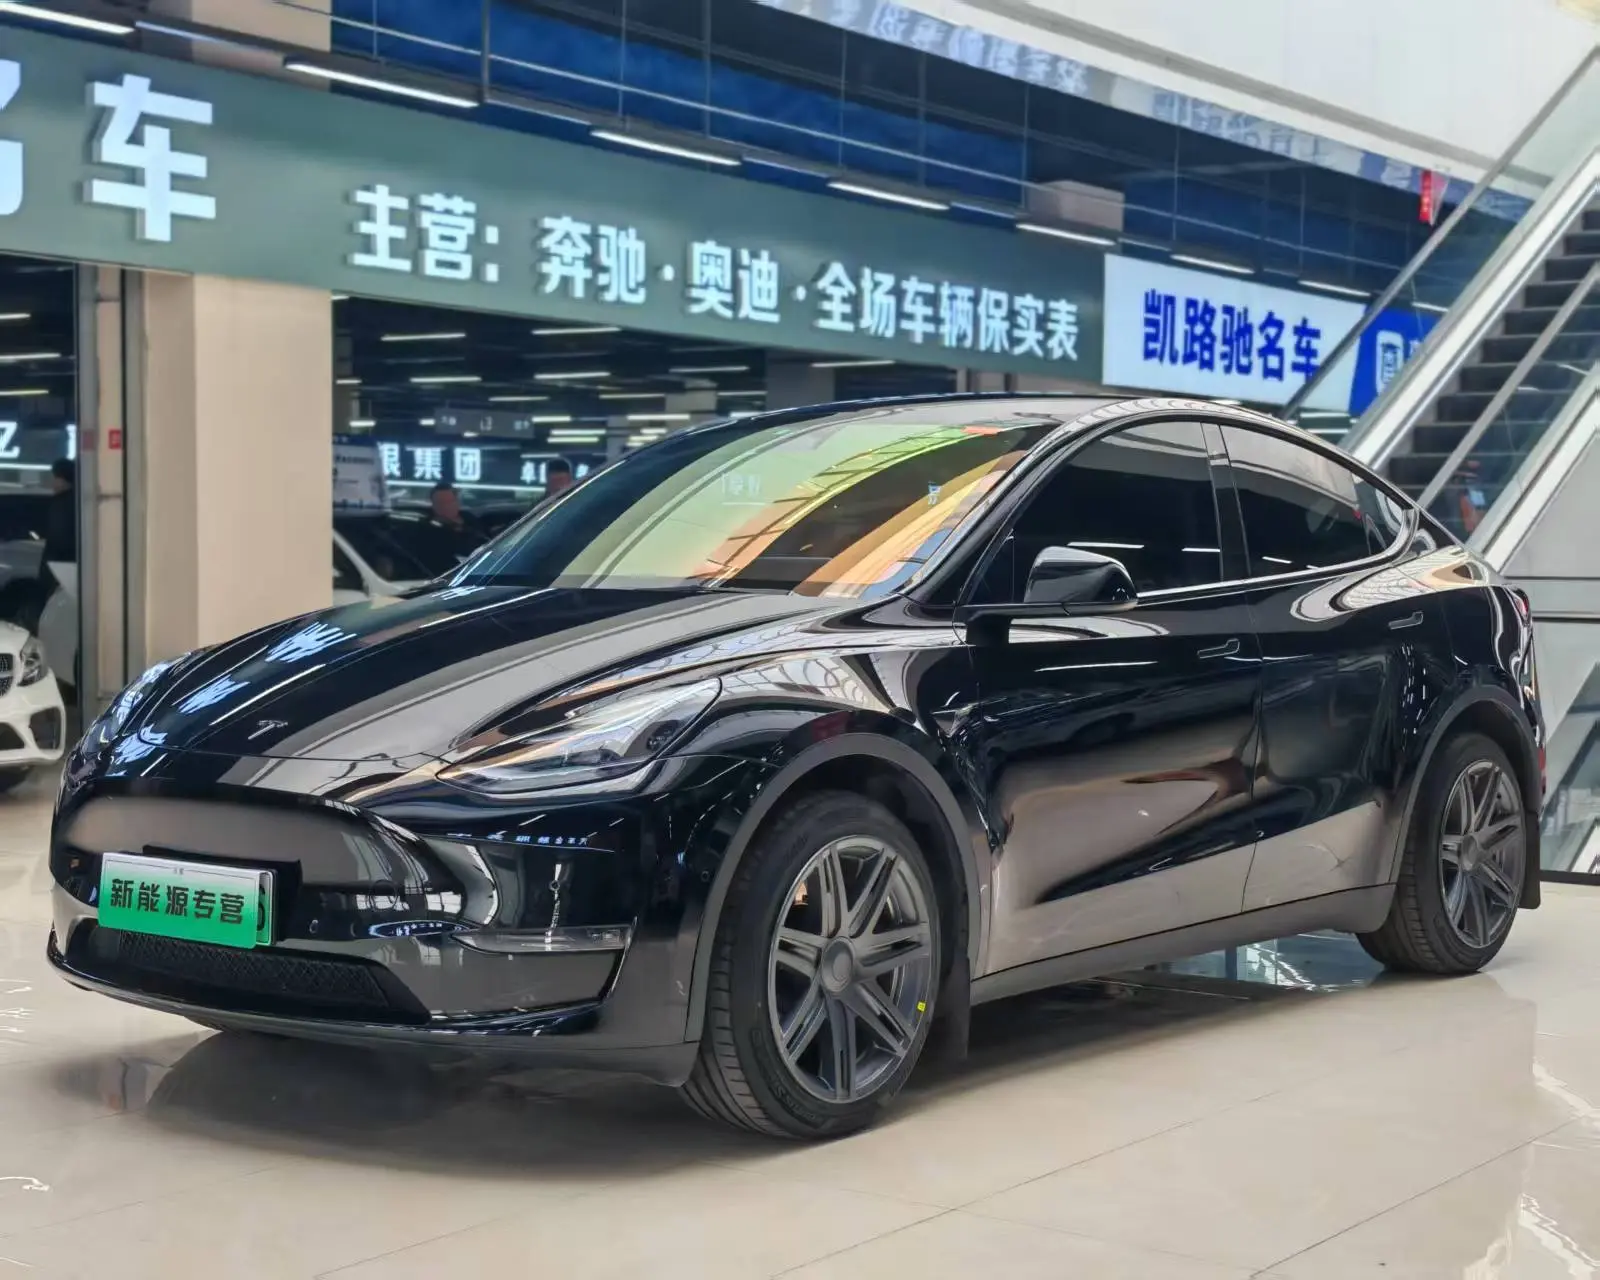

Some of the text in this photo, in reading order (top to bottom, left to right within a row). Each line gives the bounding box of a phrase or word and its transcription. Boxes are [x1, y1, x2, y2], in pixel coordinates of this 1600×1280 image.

[0, 58, 217, 242] 车
[1143, 288, 1322, 383] 凯路驰名车
[110, 878, 245, 925] 新能源专营
